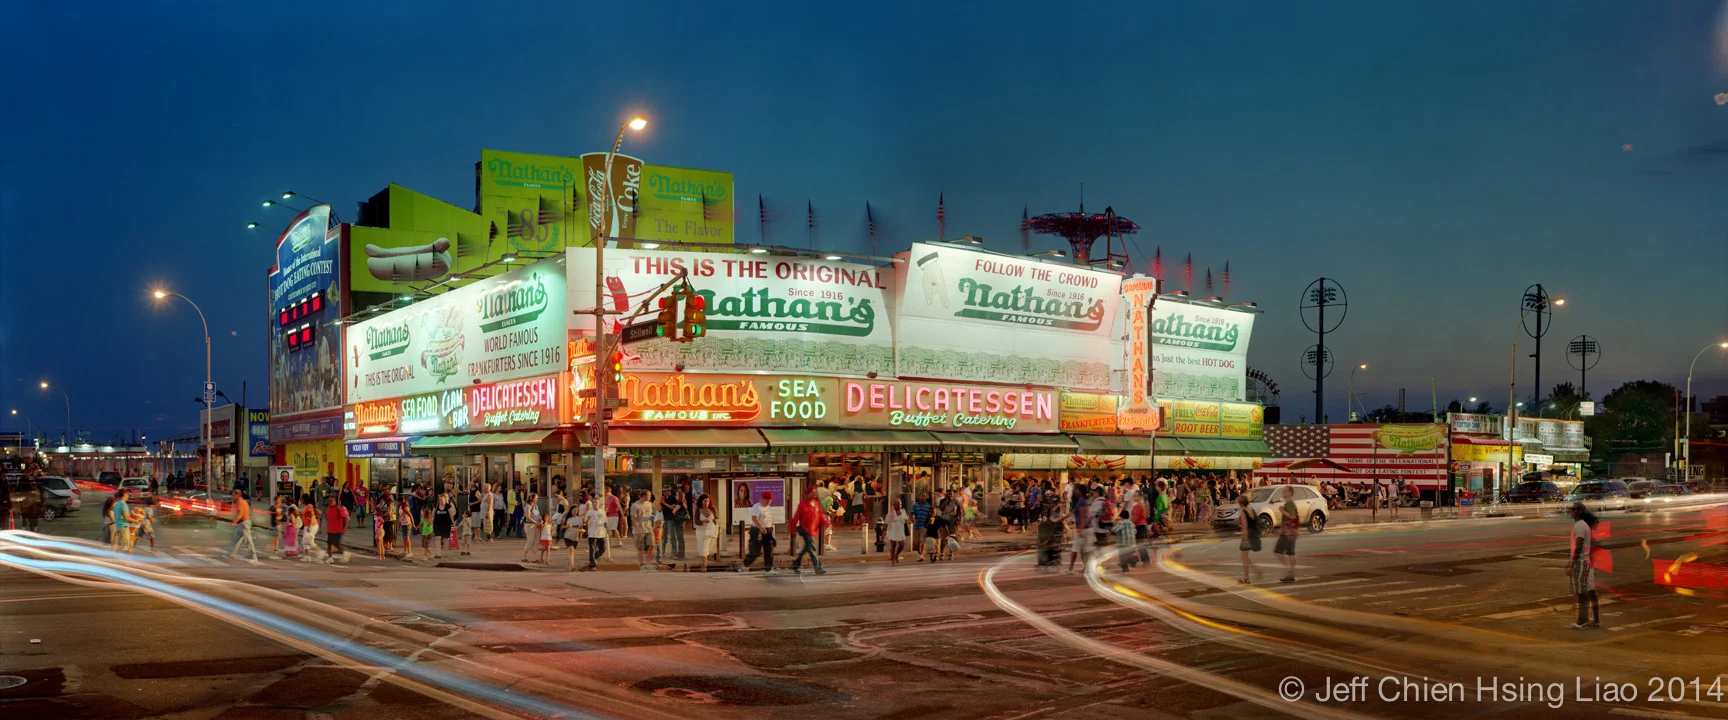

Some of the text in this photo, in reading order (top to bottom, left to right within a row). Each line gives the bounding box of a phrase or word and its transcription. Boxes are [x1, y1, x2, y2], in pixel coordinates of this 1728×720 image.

[488, 158, 574, 183] Nathan's
[617, 164, 641, 213] Coke
[648, 174, 727, 197] Nathan's
[655, 218, 723, 237] The Flavor
[283, 274, 293, 293] DOG
[293, 263, 310, 284] EATING
[309, 260, 333, 276] CONTEST
[629, 256, 887, 290] THIS IS THE ORIGINAL
[975, 259, 1098, 289] FOLLOW THE CROWD
[476, 272, 549, 320] Nathan's
[788, 287, 844, 301] Since 1916
[958, 277, 1106, 320] Nathan's
[1046, 288, 1085, 301] Since 1916
[739, 321, 808, 332] FAMOUS
[1001, 314, 1054, 326] FAMOUS
[1152, 313, 1239, 343] athan's
[1195, 315, 1225, 325] Since 1916
[366, 320, 411, 351] Nathan's
[484, 327, 538, 353] WORLD FAMOUS
[630, 326, 653, 339] Stillwell
[1159, 338, 1200, 348] FAMOUS
[431, 352, 459, 376] Nathan's
[468, 353, 516, 378] FRANKFURTERS
[517, 351, 539, 371] SINCE
[540, 346, 561, 364] 1916
[1161, 354, 1174, 363] just
[1175, 356, 1186, 364] the
[1188, 357, 1201, 366] best
[1202, 357, 1217, 367] HOT
[1218, 360, 1235, 368] DOG
[365, 365, 415, 387] THIS IS THE ORIGINAL
[472, 378, 555, 417] DELICATESSEN
[618, 374, 760, 407] Nathan's
[778, 379, 819, 398] SEA
[402, 395, 438, 420] SEA FOOD
[441, 389, 463, 417] CLAM
[607, 399, 619, 407] SURF
[771, 400, 826, 419] FOOD
[846, 382, 1052, 420] DELICATESSEN
[1062, 395, 1097, 407] Nathan's
[355, 401, 398, 424] Nathan's
[452, 405, 469, 429] BAR
[484, 408, 540, 427] Buffet Catering
[643, 409, 709, 420] FAMOUS
[890, 410, 1017, 429] Buffet Catering
[1061, 415, 1116, 430] FRANKFURTERS
[1175, 409, 1194, 418] FRIES
[1175, 423, 1220, 434] ROOT BEER
[1389, 435, 1437, 449] Nathan's
